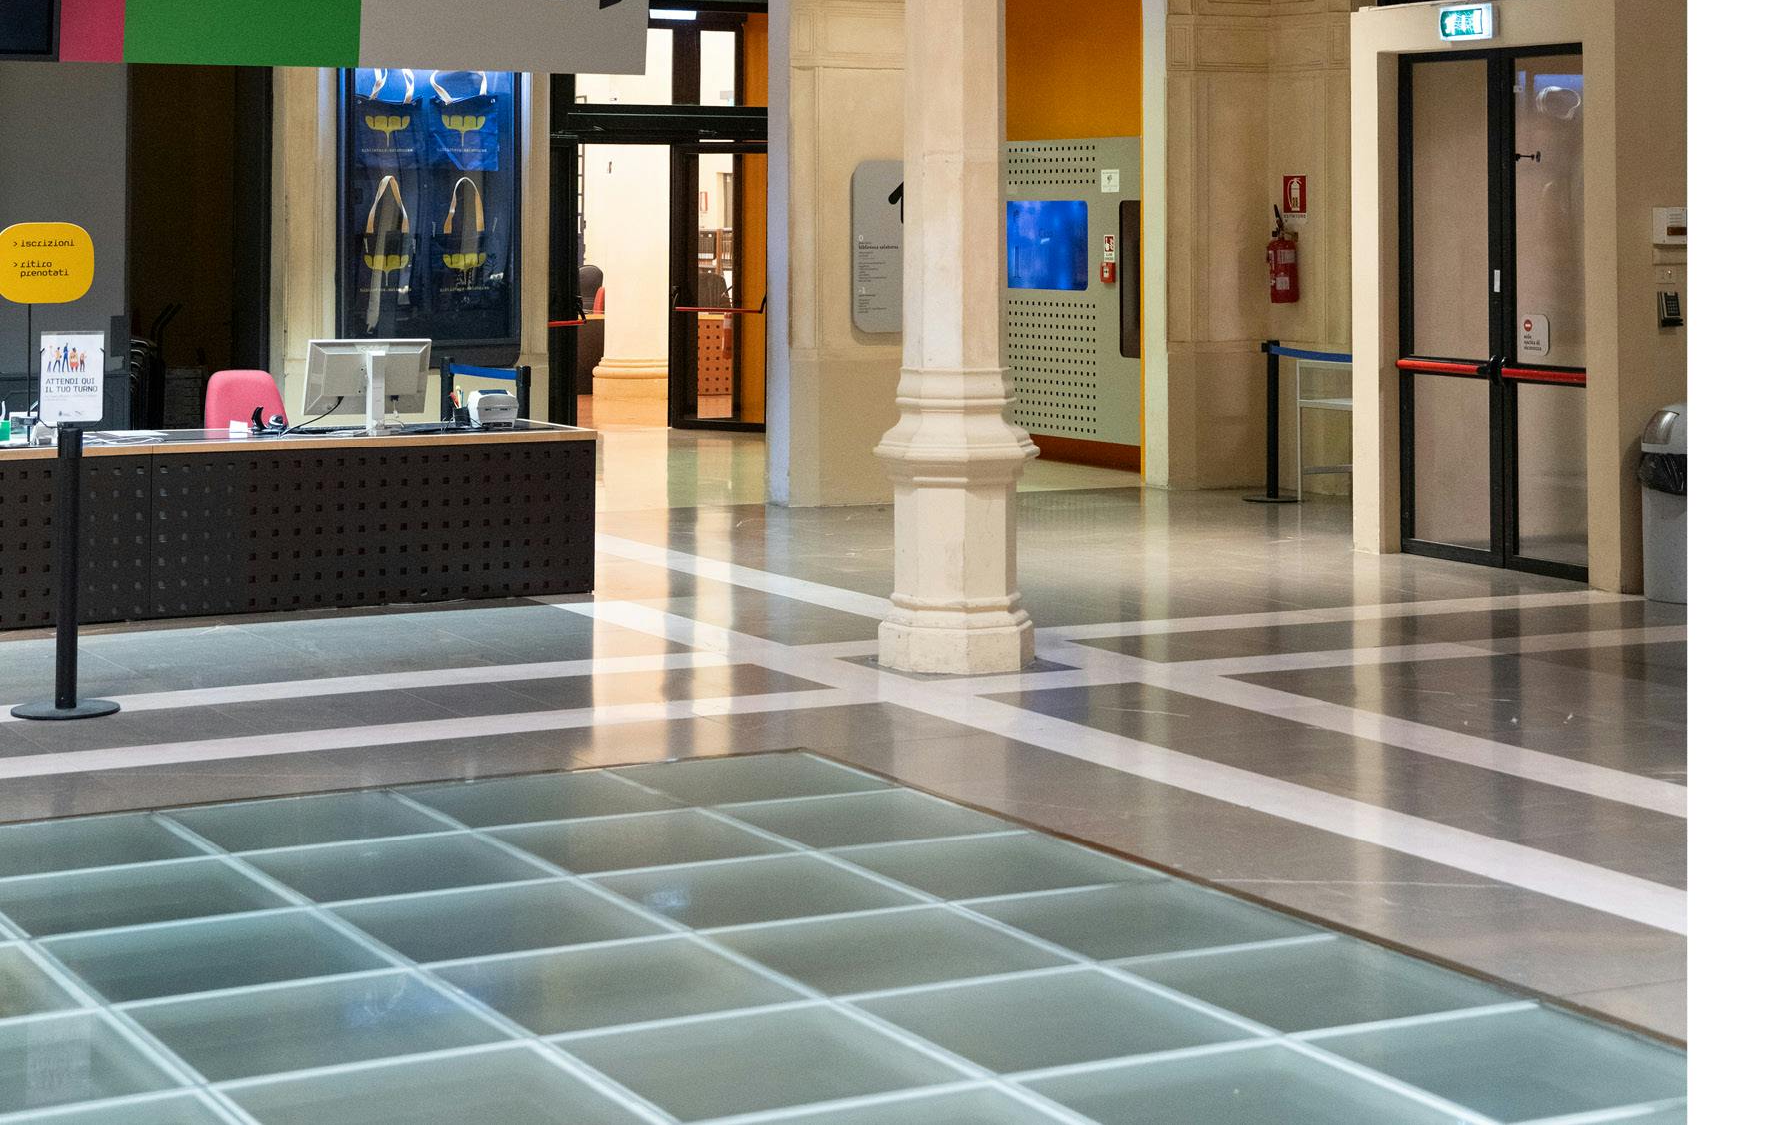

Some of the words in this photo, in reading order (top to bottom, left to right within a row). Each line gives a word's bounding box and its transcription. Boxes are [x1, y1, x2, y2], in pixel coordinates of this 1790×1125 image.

[20, 239, 75, 248] iscrizioni
[20, 259, 53, 268] ritiro
[20, 268, 69, 279] prenotati
[45, 377, 79, 385] ATTENDI
[81, 377, 95, 386] QUI
